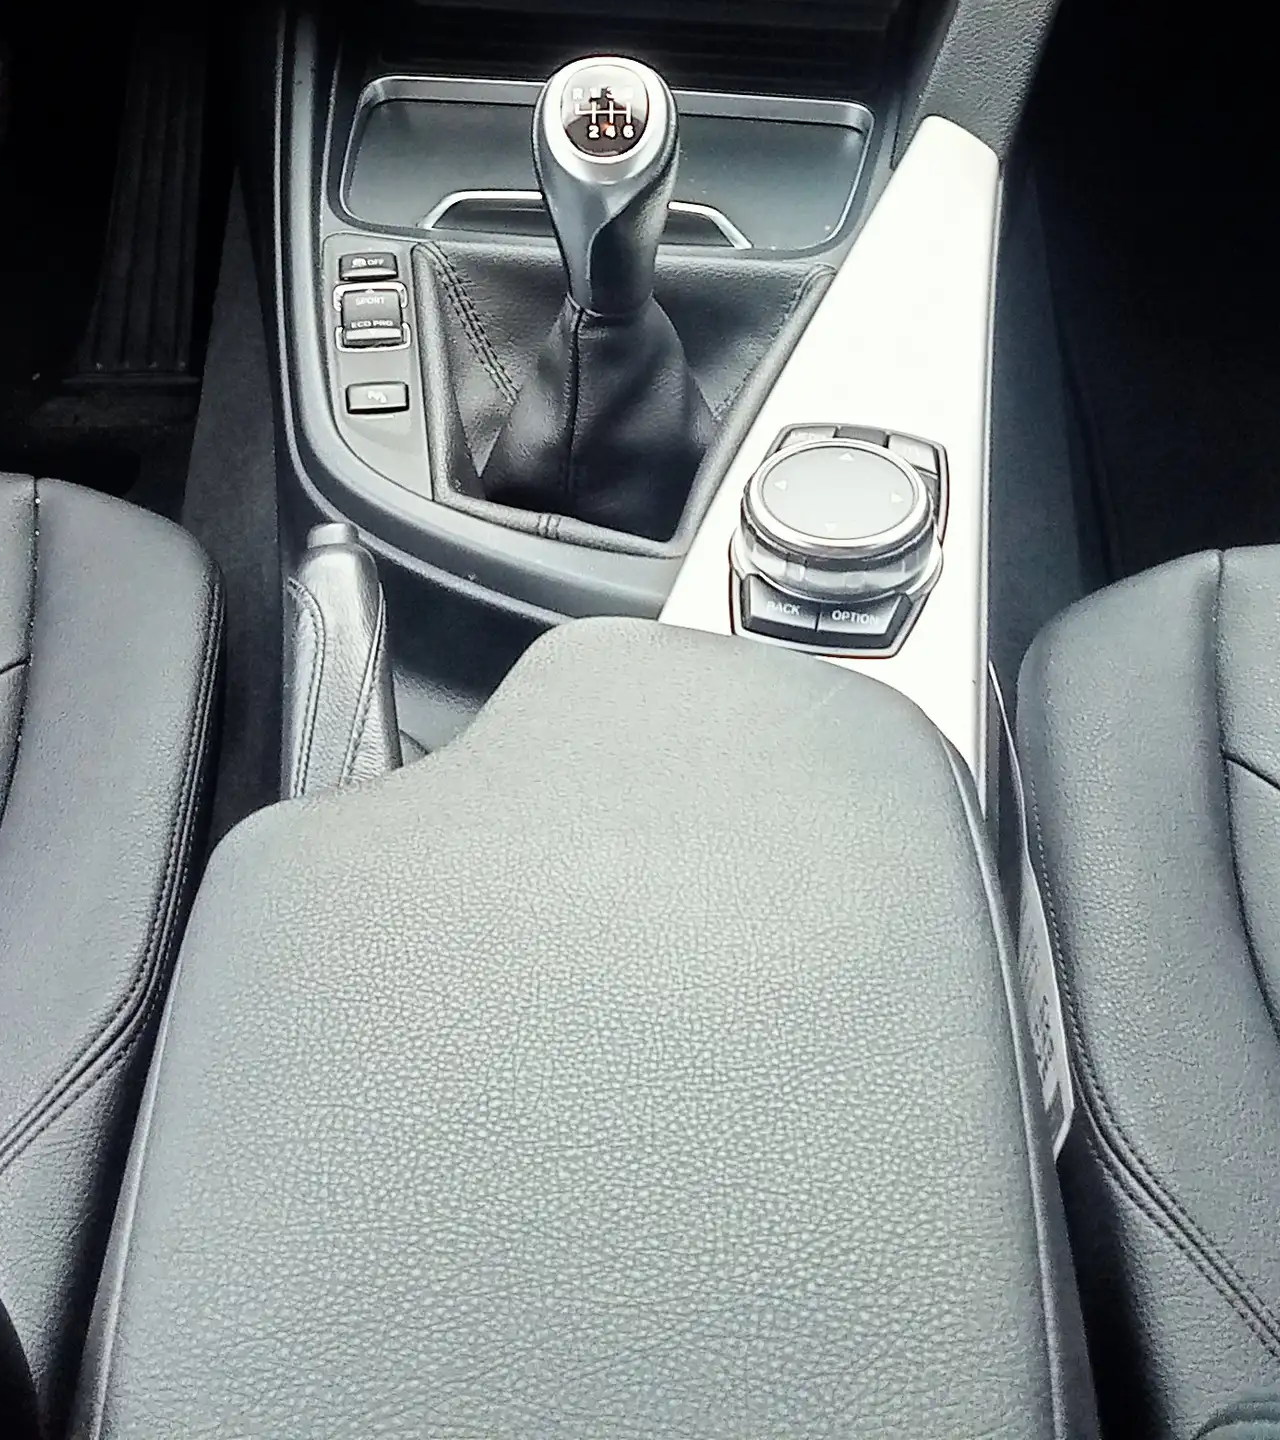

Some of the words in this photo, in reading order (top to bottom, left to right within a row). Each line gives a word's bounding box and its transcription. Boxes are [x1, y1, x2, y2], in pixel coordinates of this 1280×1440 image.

[588, 124, 600, 139] 2
[604, 124, 616, 139] 4
[622, 124, 634, 139] 6
[354, 296, 386, 306] SPORT
[350, 319, 372, 328] ECO
[372, 319, 394, 328] PRO
[766, 600, 801, 616] BACK
[831, 610, 880, 626] OPTION
